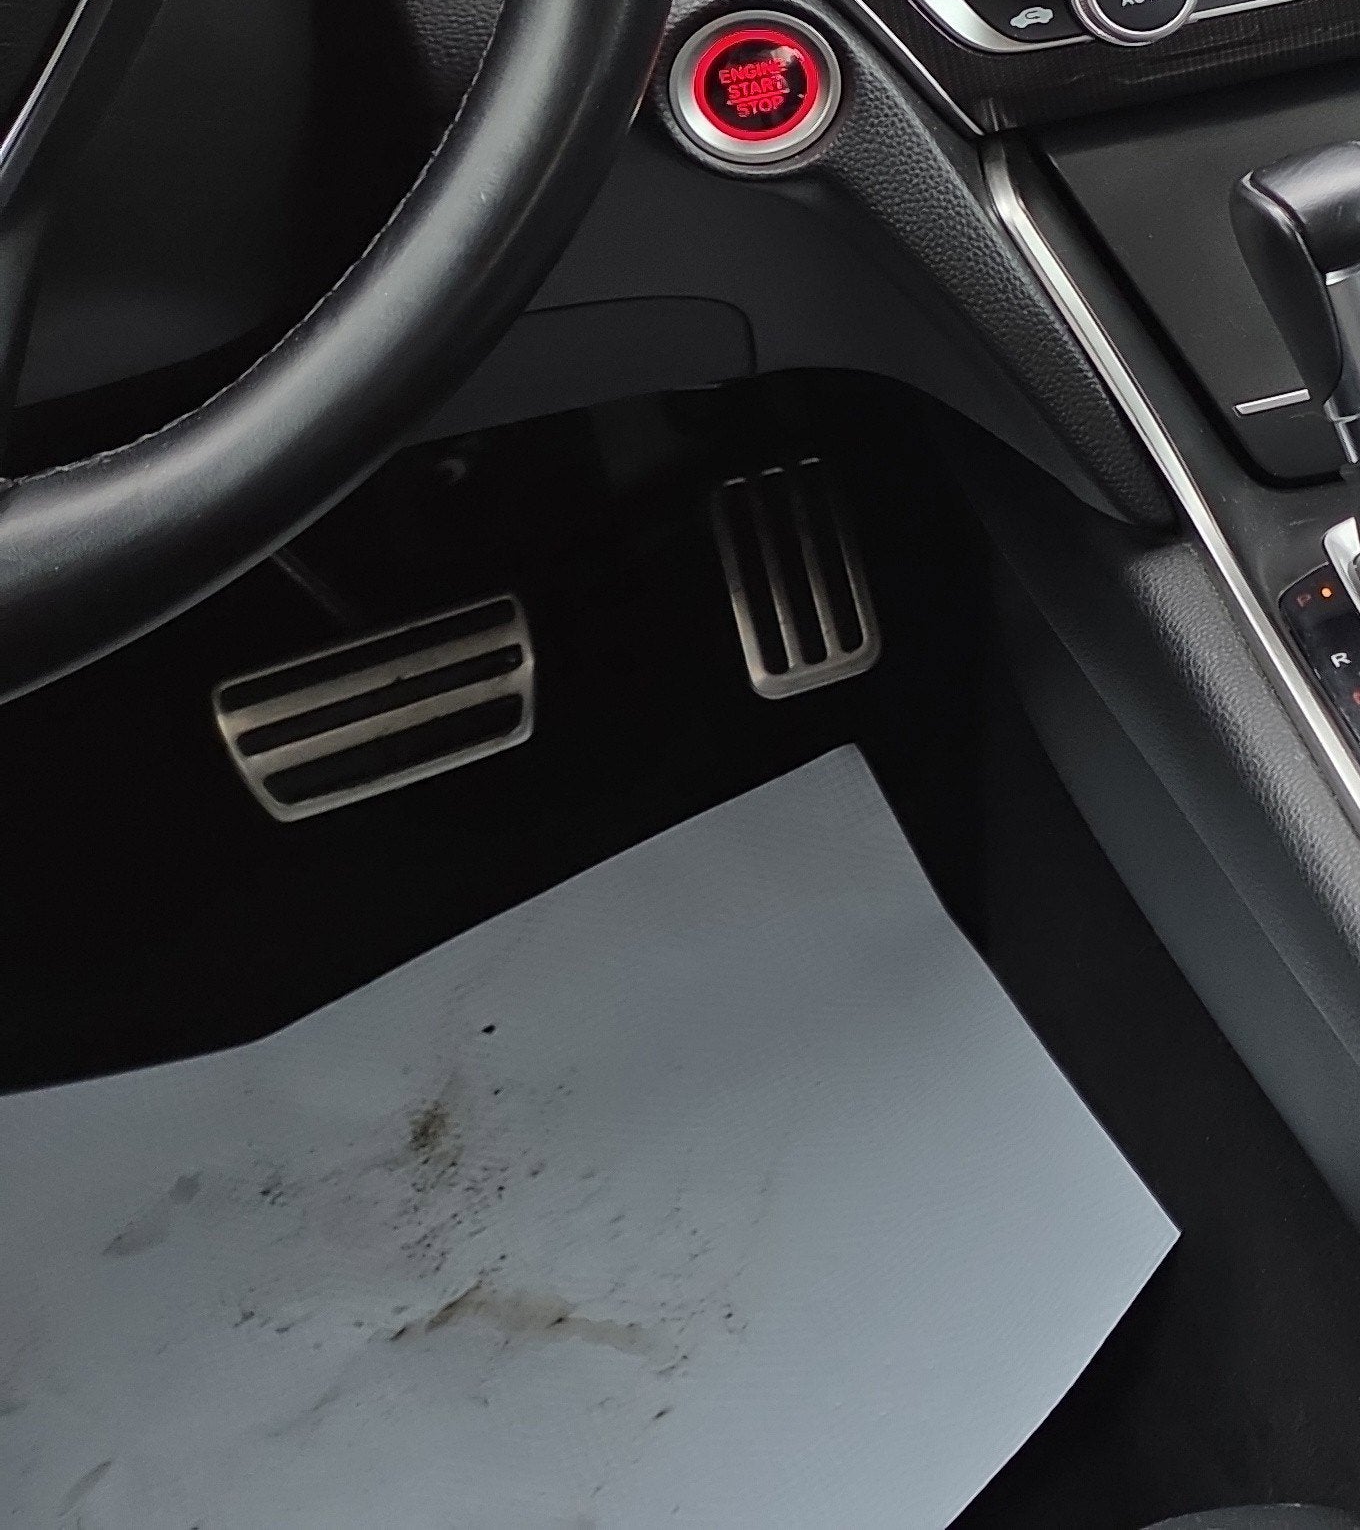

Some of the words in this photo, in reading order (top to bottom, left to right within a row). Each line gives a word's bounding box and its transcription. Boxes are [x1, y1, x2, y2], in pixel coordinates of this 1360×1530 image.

[718, 59, 786, 84] ENGINE
[729, 76, 786, 97] START
[737, 96, 784, 117] STOP
[1330, 652, 1352, 668] R
